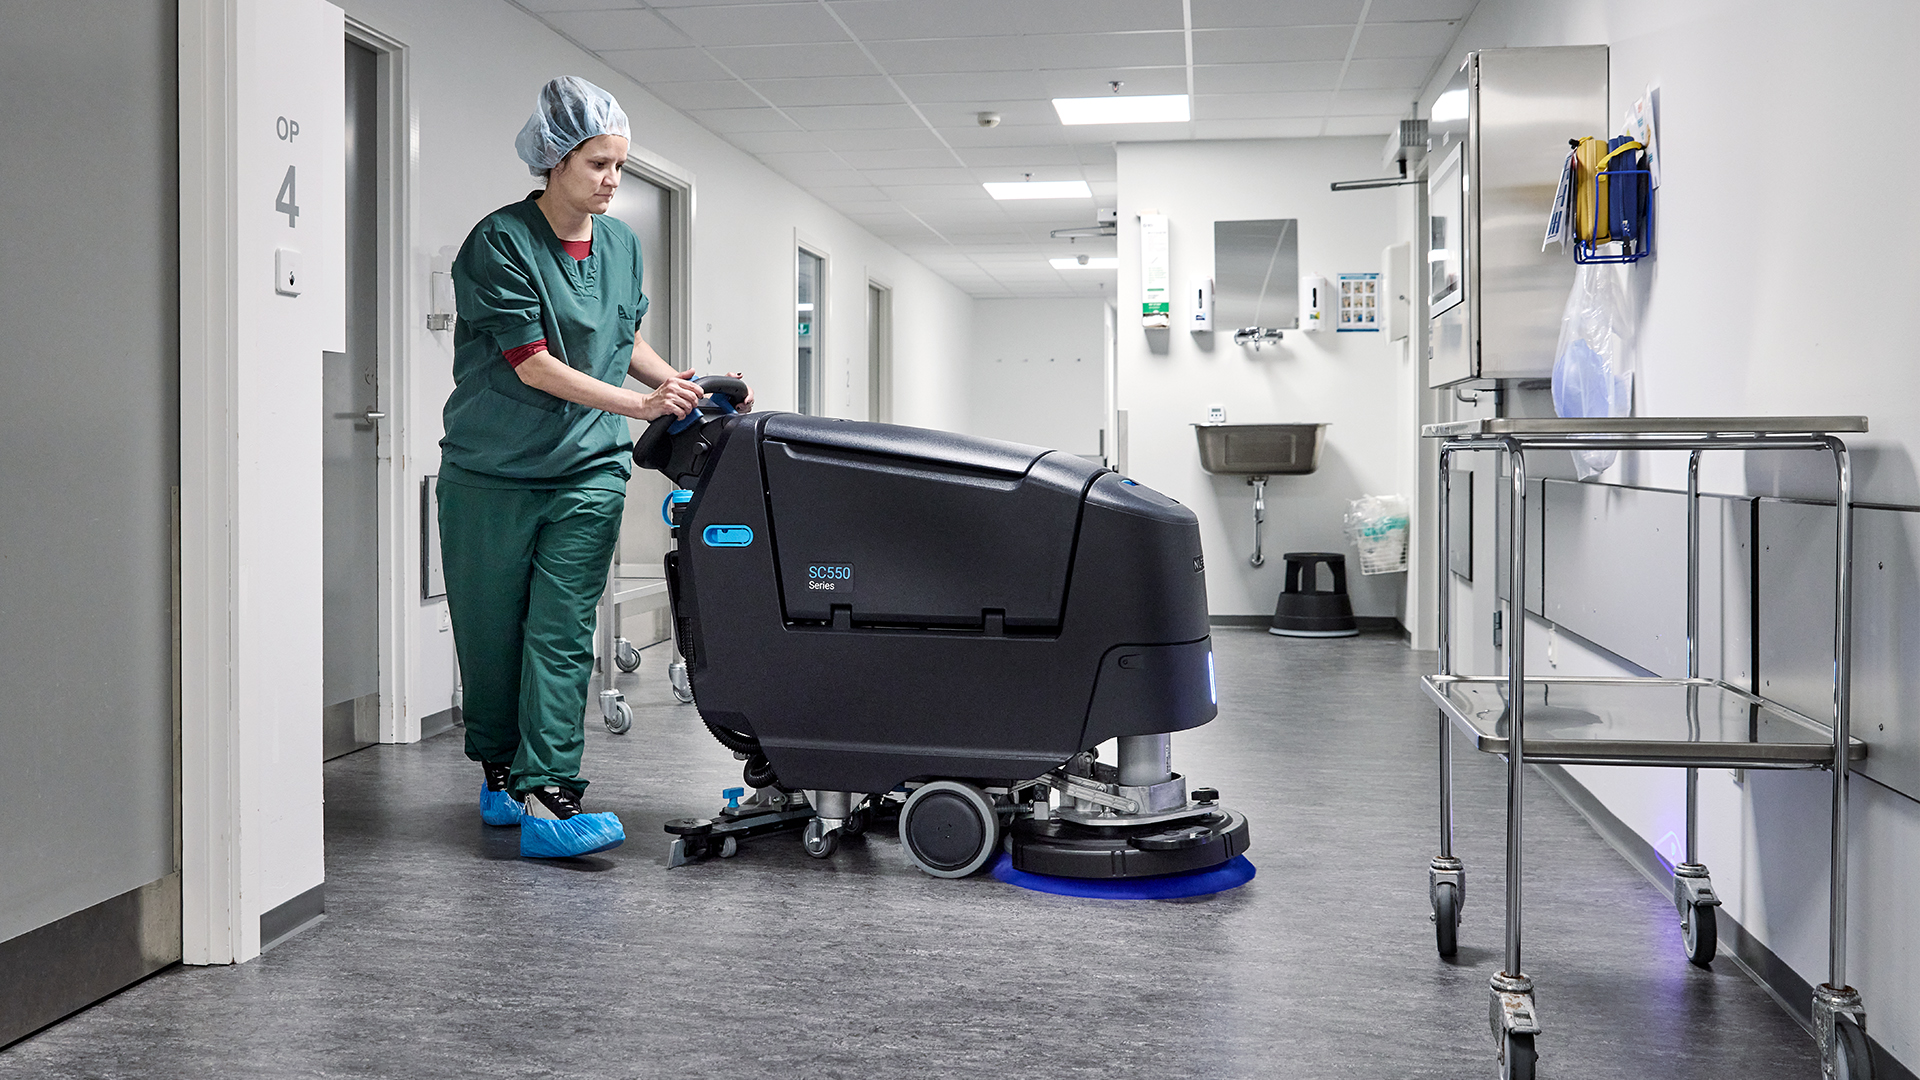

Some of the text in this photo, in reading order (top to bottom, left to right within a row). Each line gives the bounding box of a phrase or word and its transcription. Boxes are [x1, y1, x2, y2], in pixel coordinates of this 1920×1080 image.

[276, 115, 300, 143] OP
[275, 164, 300, 229] 4
[706, 340, 712, 365] 3
[808, 565, 851, 580] SC550
[808, 580, 835, 590] Series
